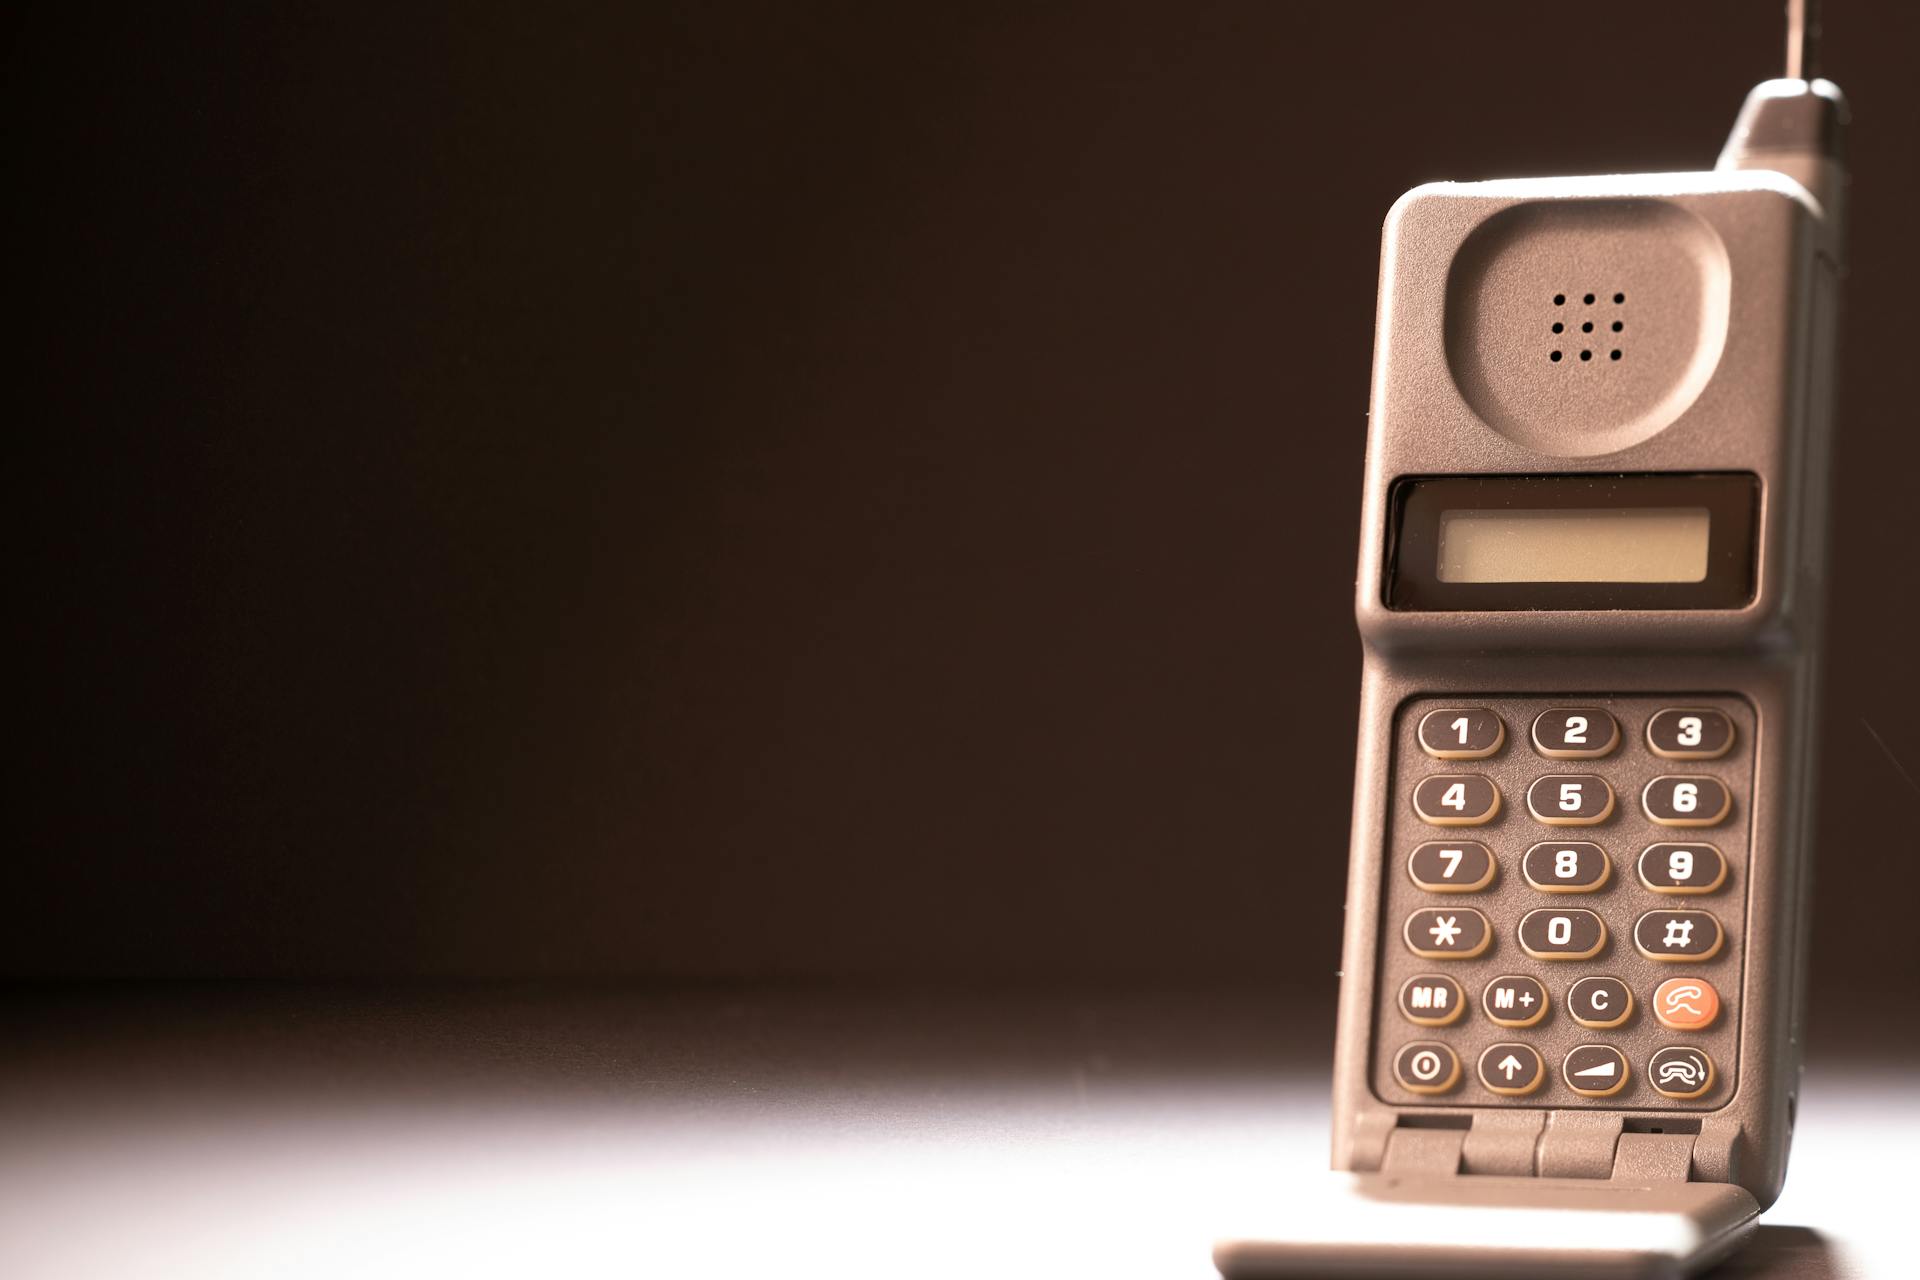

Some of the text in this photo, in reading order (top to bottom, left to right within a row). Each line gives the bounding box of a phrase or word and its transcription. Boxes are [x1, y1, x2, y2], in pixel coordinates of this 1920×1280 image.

[1450, 717, 1469, 745] 1
[1563, 716, 1588, 744] 2
[1677, 716, 1702, 746] 3
[1441, 783, 1466, 811] 4
[1558, 783, 1582, 812] 5
[1672, 782, 1698, 813] 6
[1439, 849, 1463, 879] 7
[1554, 849, 1578, 879] 8
[1668, 850, 1694, 880] 9
[1547, 916, 1572, 945] 0
[1662, 918, 1694, 949] #
[1411, 986, 1448, 1009] MR
[1590, 989, 1609, 1011] C
